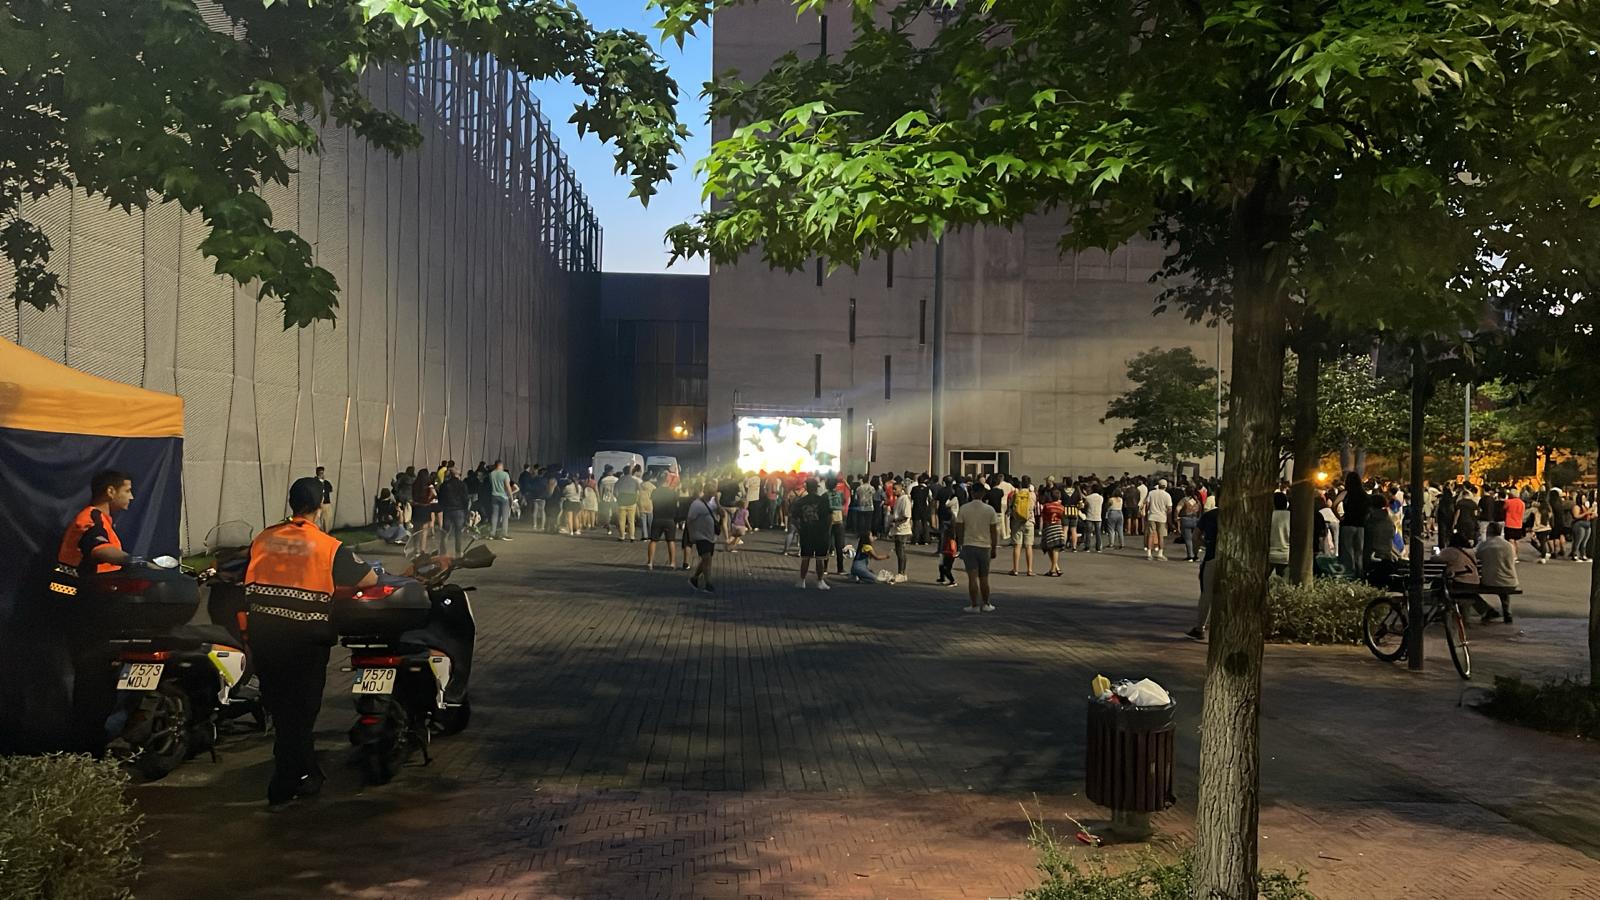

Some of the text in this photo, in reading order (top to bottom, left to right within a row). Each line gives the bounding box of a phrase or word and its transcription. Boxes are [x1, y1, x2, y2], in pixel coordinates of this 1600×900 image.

[364, 669, 394, 680] 7570
[127, 676, 151, 688] MDJ
[361, 680, 384, 692] MDJ
